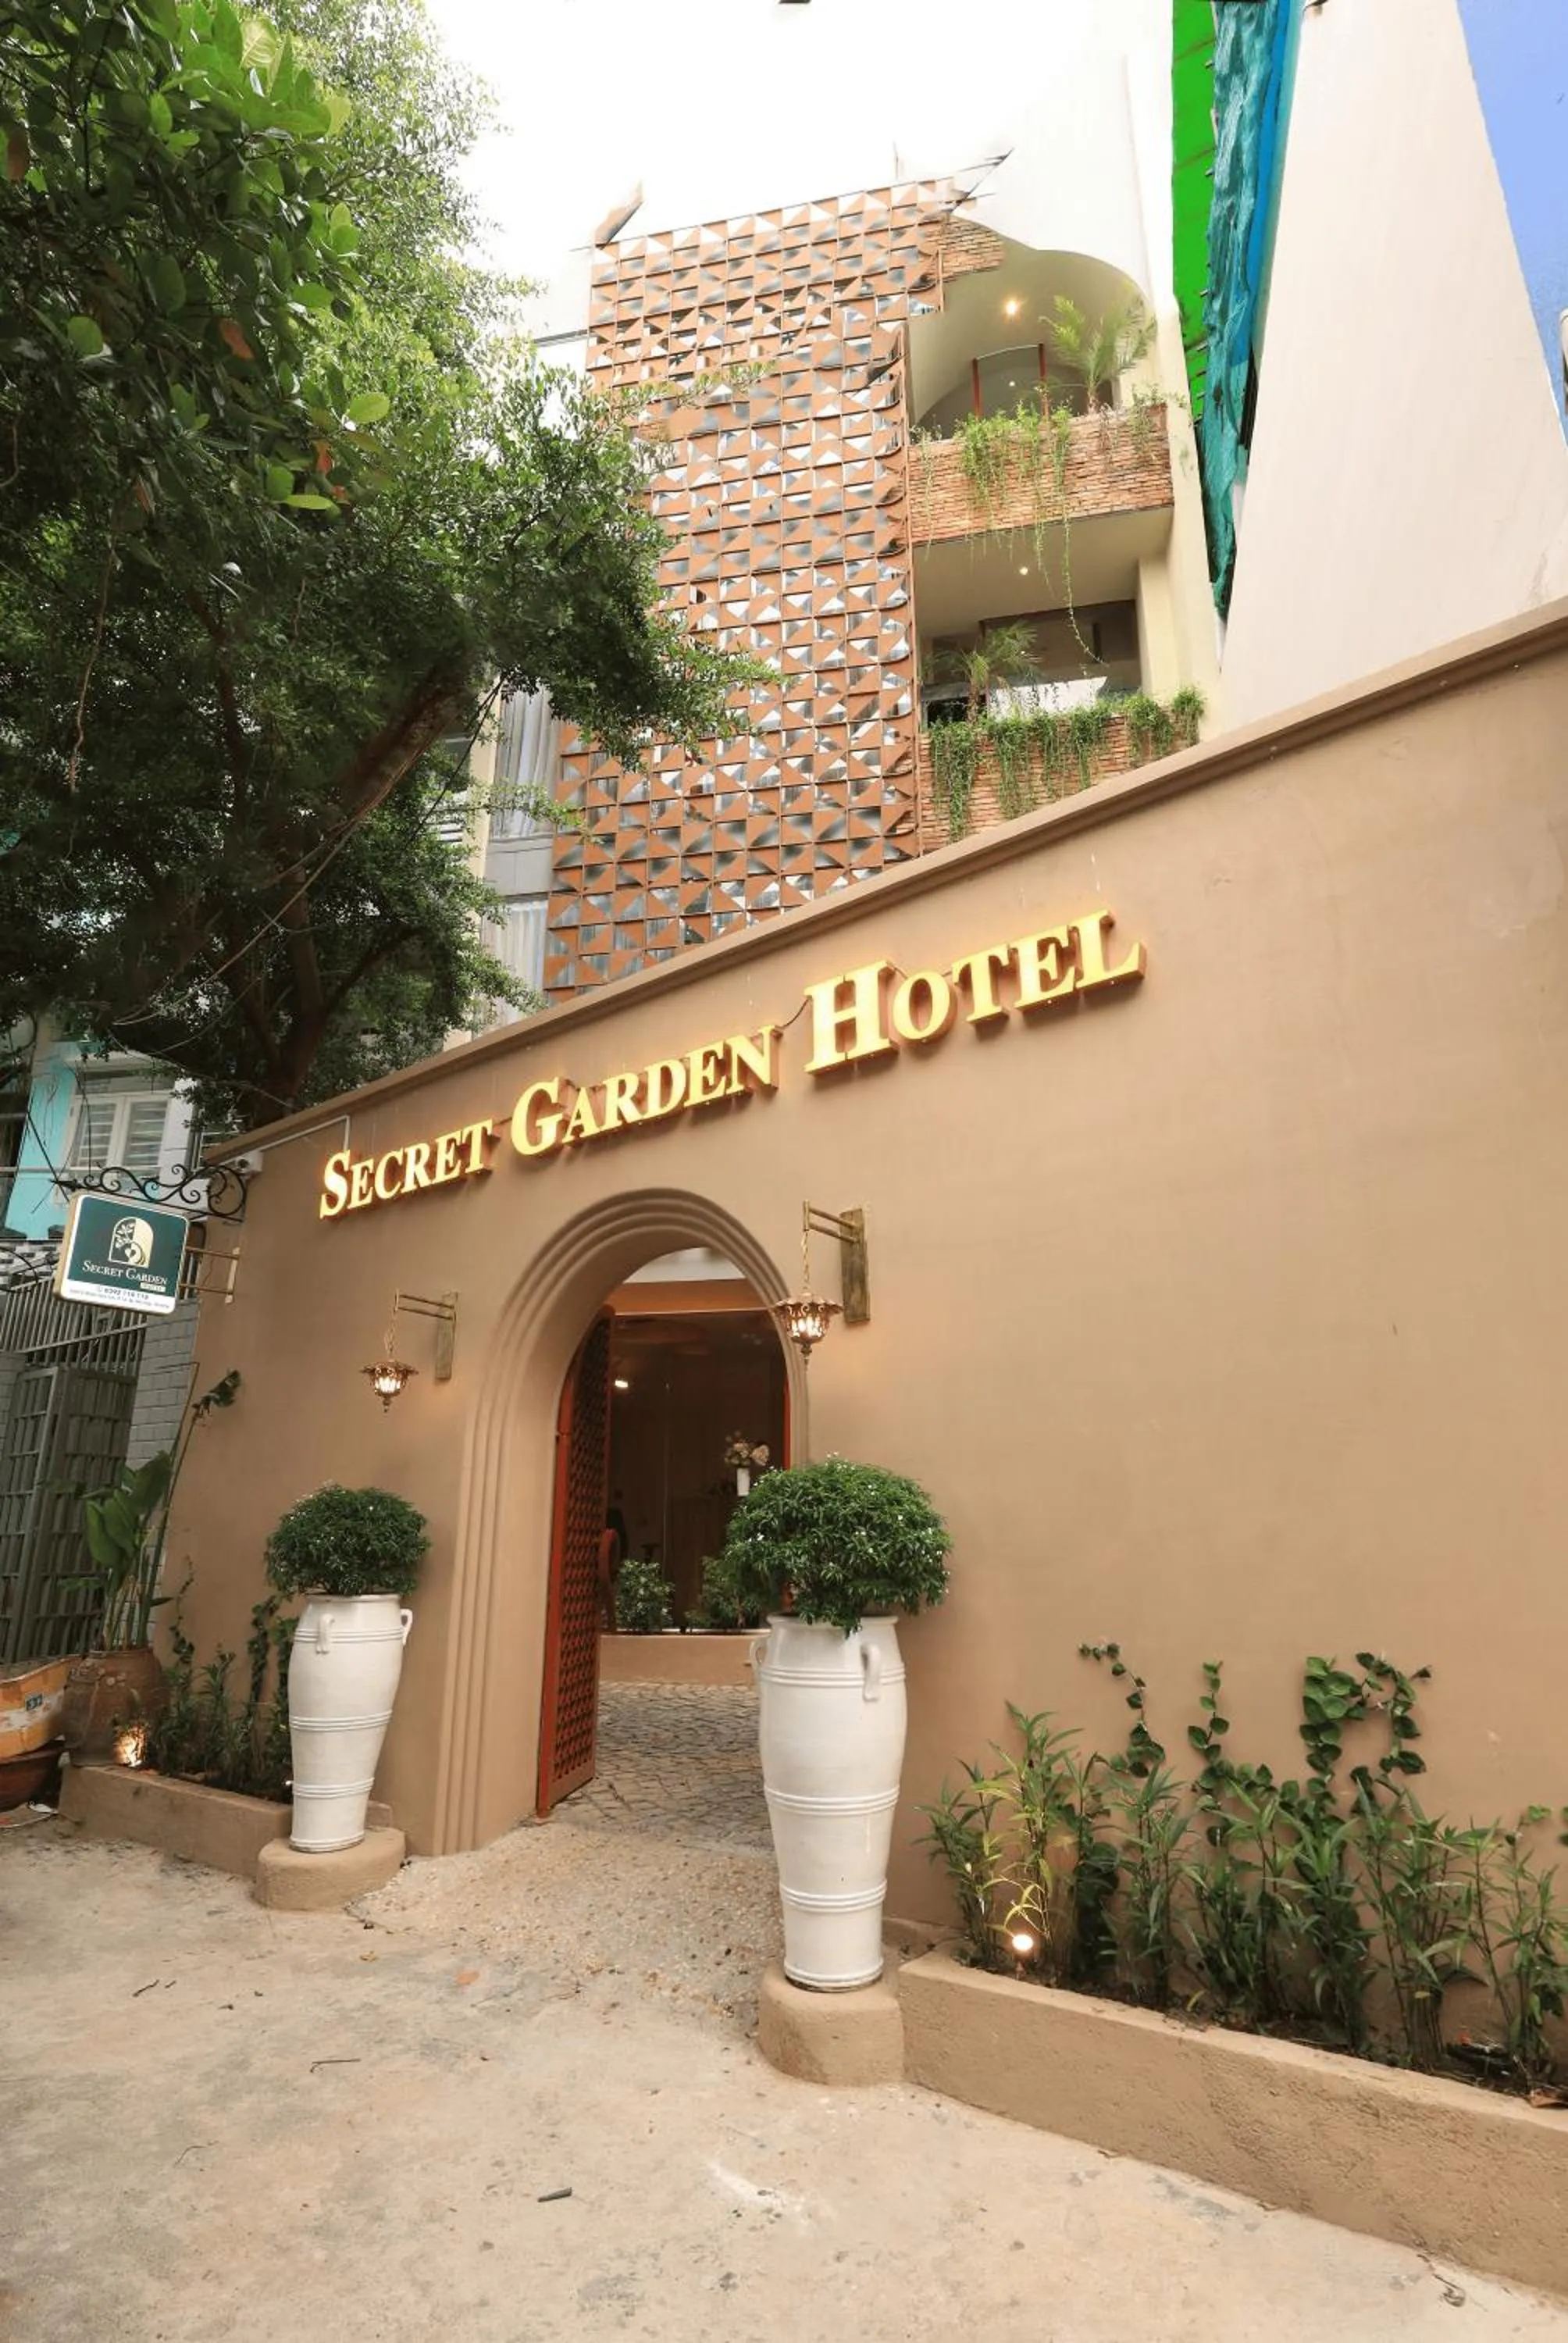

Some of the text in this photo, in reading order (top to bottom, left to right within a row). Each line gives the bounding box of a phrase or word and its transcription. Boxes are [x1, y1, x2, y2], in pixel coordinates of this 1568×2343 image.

[319, 908, 1146, 1219] SECRET GARDEN HOTEL
[82, 1260, 167, 1285] SECRET GARDEN
